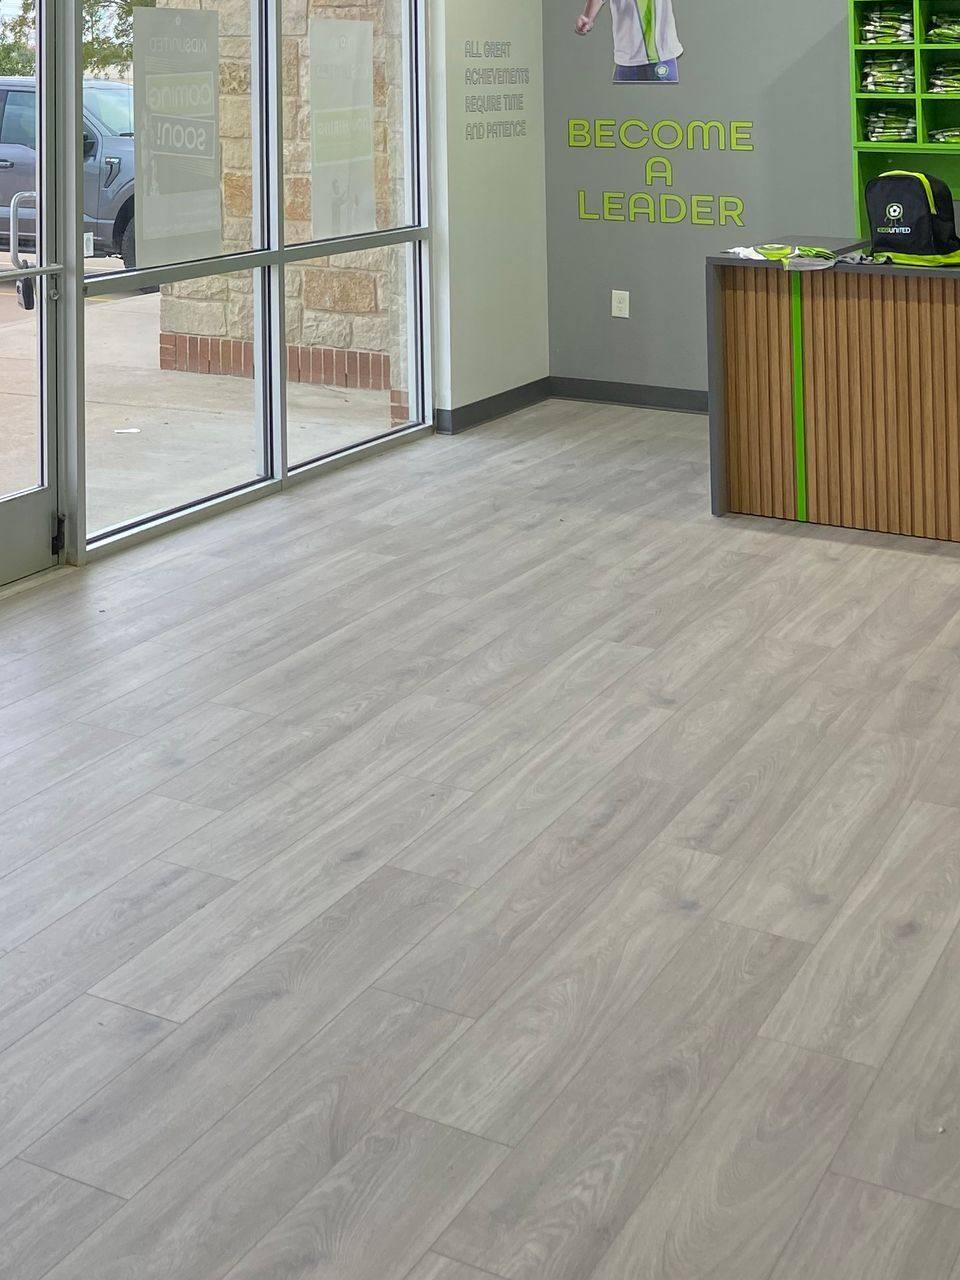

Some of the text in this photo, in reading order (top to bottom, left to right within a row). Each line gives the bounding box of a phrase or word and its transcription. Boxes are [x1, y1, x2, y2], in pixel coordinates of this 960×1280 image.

[464, 40, 512, 58] ALL GREAT
[464, 67, 530, 86] ACHIEVEMENTS
[464, 93, 524, 114] REQUIRE TIME
[465, 119, 527, 141] AND PATIENCE
[567, 118, 755, 151] BECOME
[644, 156, 673, 187] A
[577, 190, 746, 227] LEADER
